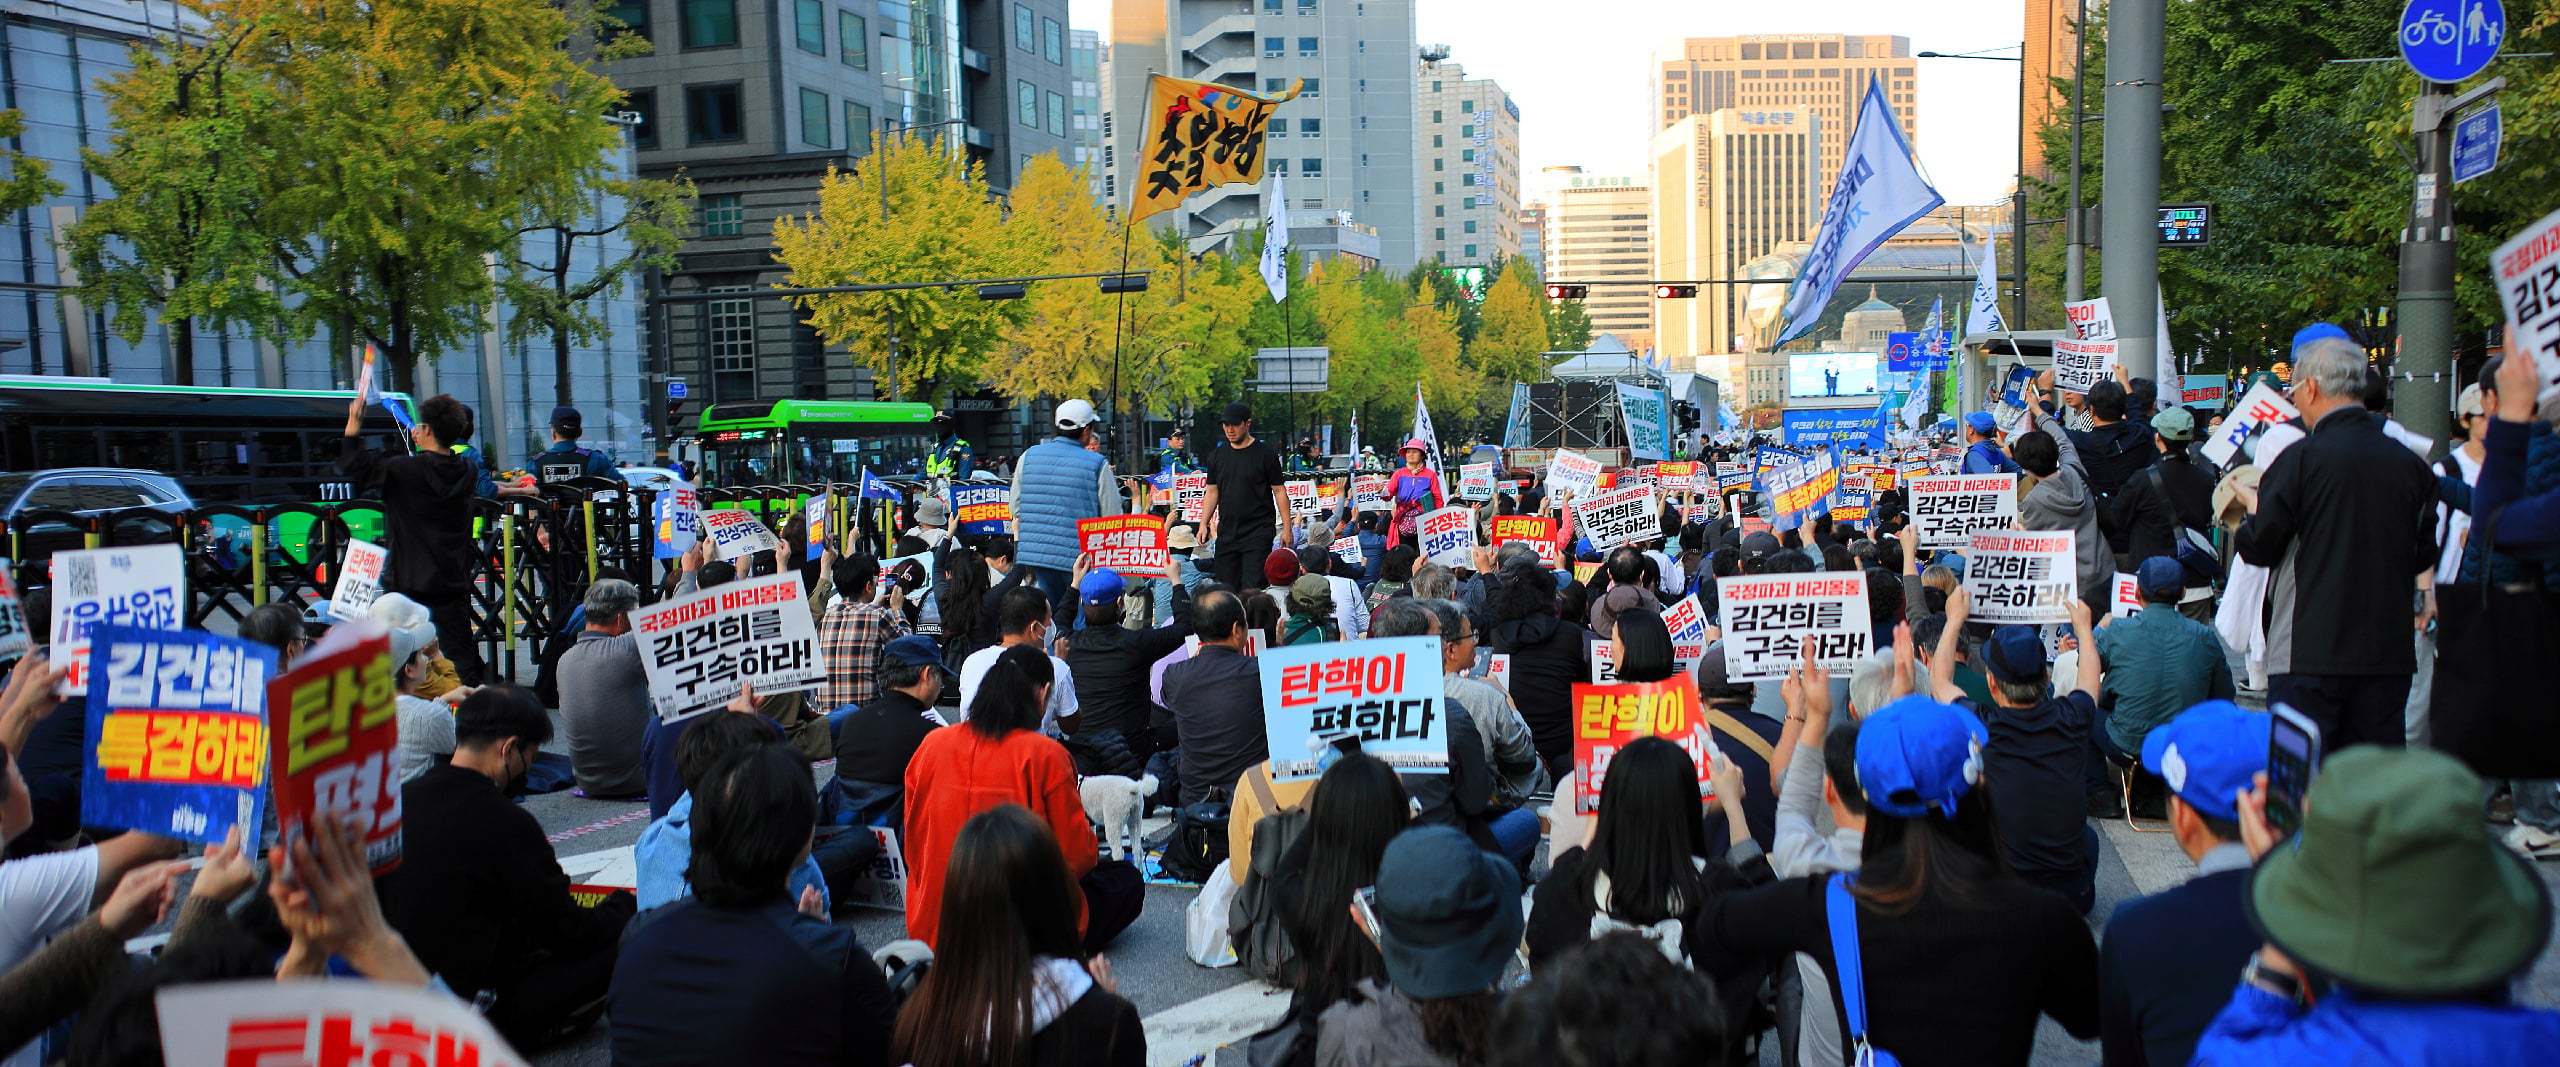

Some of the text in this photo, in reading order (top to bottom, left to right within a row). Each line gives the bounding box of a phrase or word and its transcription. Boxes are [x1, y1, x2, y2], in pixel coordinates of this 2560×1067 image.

[2057, 352, 2104, 370] 김건희를
[1559, 454, 1599, 473] 국정농단
[1659, 464, 1690, 475] 탄핵이
[1770, 452, 1833, 494] 김건희를
[320, 483, 350, 500] 1711
[1463, 478, 1487, 487] 탄핵이
[1467, 487, 1491, 495] 평화다
[1774, 466, 1840, 516] 특검하라!
[1913, 478, 2012, 493] 국정파괴 비리몸통
[955, 487, 1010, 506] 김건희를
[1580, 486, 1650, 512] 국정파괴 비리몸통
[1917, 495, 1998, 515] 김건희를
[1423, 510, 1469, 537] 국정농단
[1587, 500, 1643, 527] 김건희를
[1087, 530, 1156, 550] 윤석열을
[1496, 519, 1546, 539] 탄핵이
[1597, 514, 1656, 540] 구속하라!
[1425, 529, 1473, 558] 진상규명!
[1970, 535, 2070, 552] 국정파괴 비리몸통
[347, 548, 383, 579] 탄핵이
[1970, 555, 2051, 581] 김건희를
[1724, 580, 1860, 601] 국정파괴 비리몸통
[1974, 583, 2070, 608] 구속하라!
[640, 580, 797, 633] 국정파괴 비리몸통
[1732, 602, 1843, 633] 김건희를
[653, 608, 782, 670] 김건희를
[1744, 633, 1866, 662] 구속하라!
[107, 643, 263, 712] 김건희를
[675, 638, 812, 696] 구속하라!
[1281, 653, 1406, 709] 탄핵이
[1310, 698, 1435, 742] 평화다
[1581, 685, 1685, 739] 탄핵이
[97, 714, 269, 787] 특검하라!
